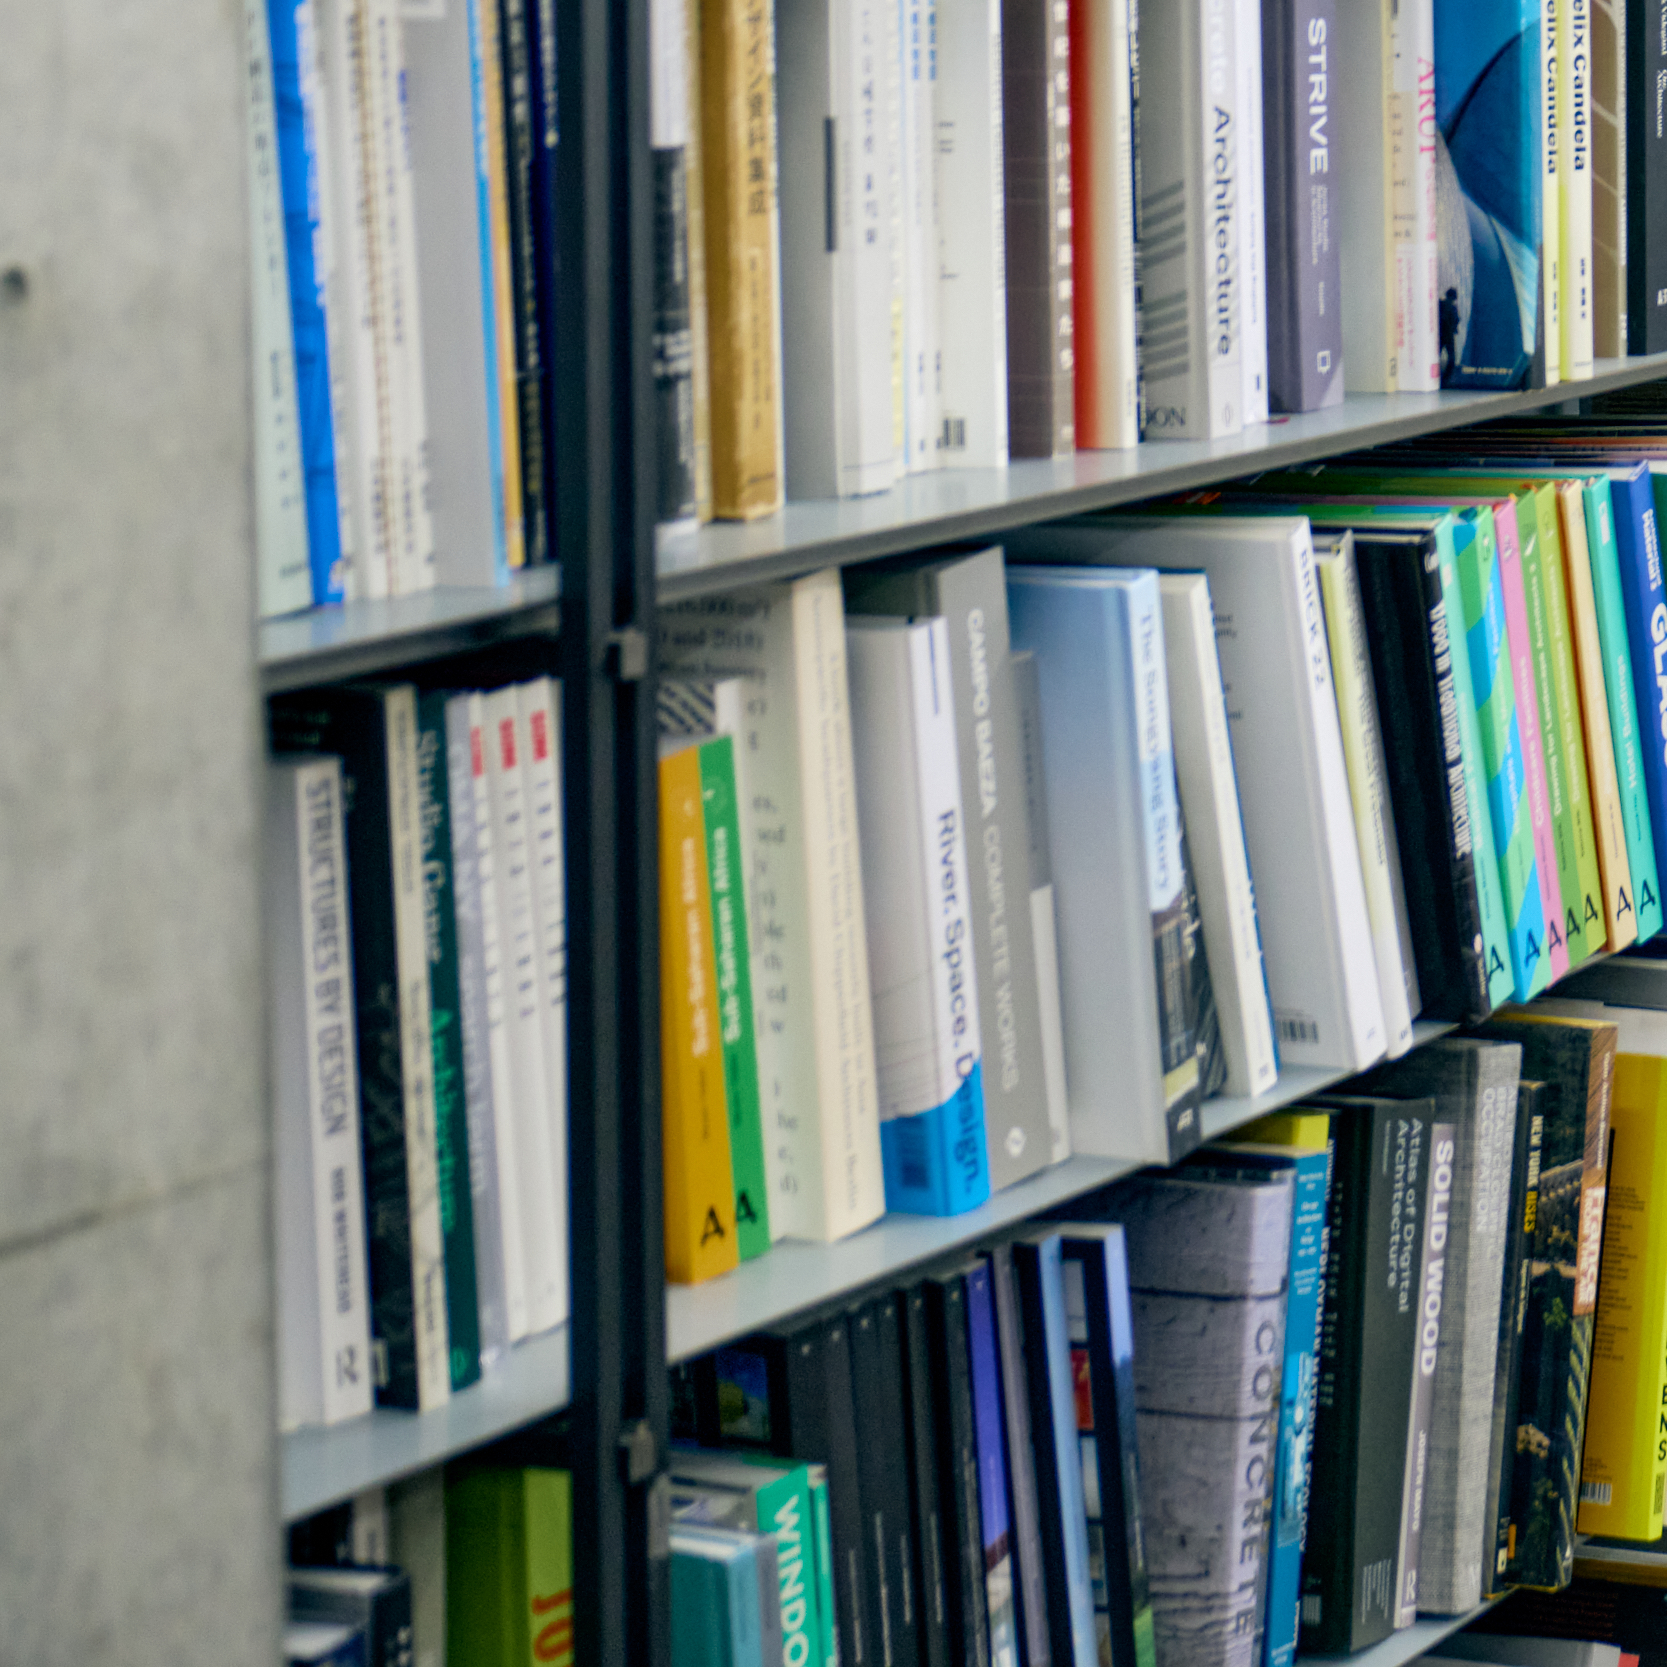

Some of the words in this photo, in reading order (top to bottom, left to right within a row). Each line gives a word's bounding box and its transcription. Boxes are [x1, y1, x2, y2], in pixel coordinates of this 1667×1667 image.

[1307, 17, 1328, 174] STRIVE
[1547, 55, 1557, 174] Candela
[1573, 53, 1588, 171] Candela
[1213, 105, 1232, 357] Architecture
[1431, 1138, 1455, 1247] SOLID
[1420, 1257, 1445, 1377] WOOD
